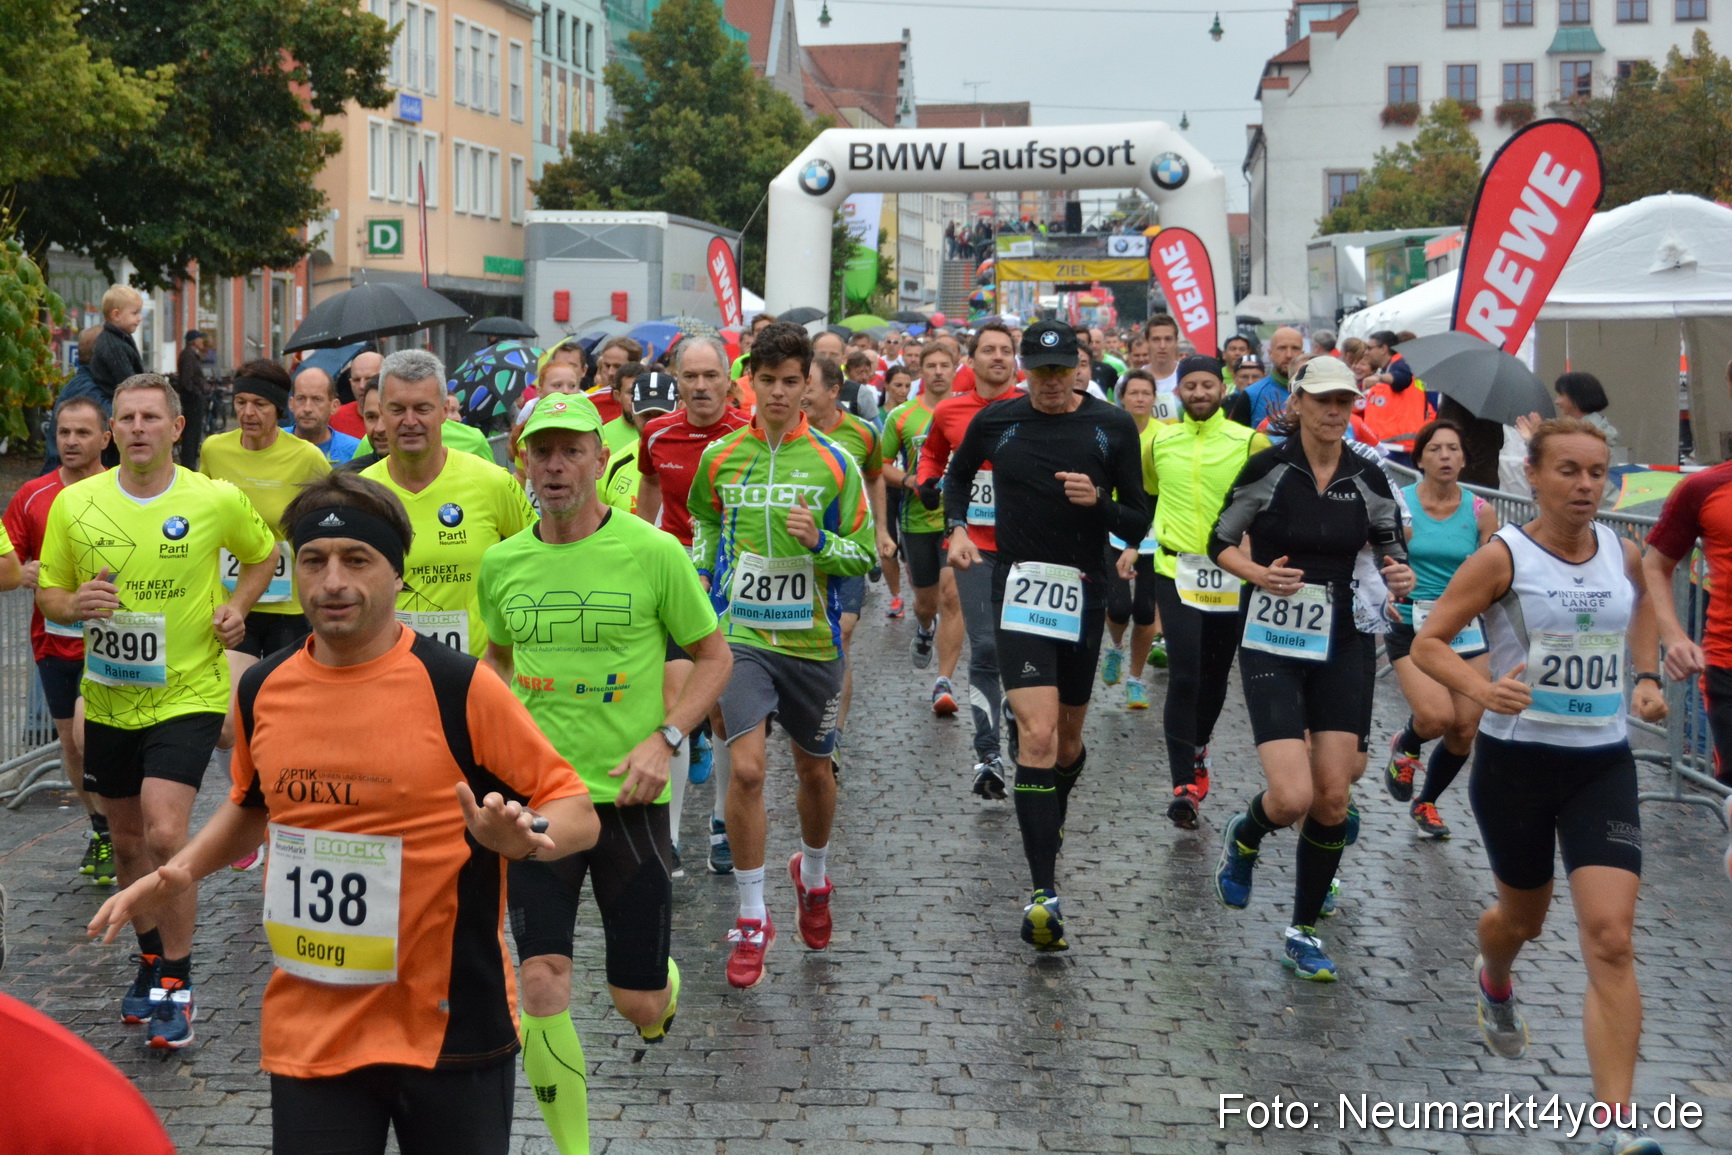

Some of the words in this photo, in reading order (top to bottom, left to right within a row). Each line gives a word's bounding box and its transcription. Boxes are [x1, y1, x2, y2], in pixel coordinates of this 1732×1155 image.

[848, 142, 947, 171] BMW
[958, 139, 1135, 174] Laufsport
[373, 224, 398, 250] D
[1465, 151, 1582, 348] REWE
[1056, 264, 1090, 277] ZIEL
[1151, 402, 1169, 419] 00
[721, 483, 825, 510] BOCK
[969, 483, 992, 504] 28
[1327, 490, 1357, 499] FALKE
[974, 508, 996, 518] Chris
[438, 529, 467, 540] Partl
[159, 543, 189, 554] Partl
[228, 554, 285, 577] 29
[411, 565, 430, 575] THE
[432, 564, 459, 574] NEXT
[126, 580, 146, 591] THE
[148, 579, 175, 590] NEXT
[422, 575, 438, 584] 100
[440, 572, 472, 583] YEARS
[1196, 568, 1222, 589] 80
[134, 591, 152, 601] 100
[154, 588, 186, 600] YEARS
[739, 572, 806, 602] 2870
[1013, 578, 1078, 612] 2705
[1296, 586, 1326, 598] OCK
[1558, 590, 1612, 599] INTERSPORT
[1193, 594, 1222, 604] Tobias
[1562, 598, 1605, 607] LANGE
[417, 614, 460, 625] BOCK
[1029, 612, 1057, 627] Klaus
[1256, 595, 1325, 631] 2812
[90, 627, 157, 662] 2890
[1265, 631, 1305, 648] Daniela
[105, 664, 141, 679] Rainer
[1538, 654, 1618, 690] 2004
[517, 673, 555, 692] HERZ
[576, 683, 631, 694] Bretschneider
[1568, 699, 1592, 713] Eva
[314, 836, 386, 860] BOCK
[286, 866, 367, 927] 138
[296, 935, 345, 967] Georg
